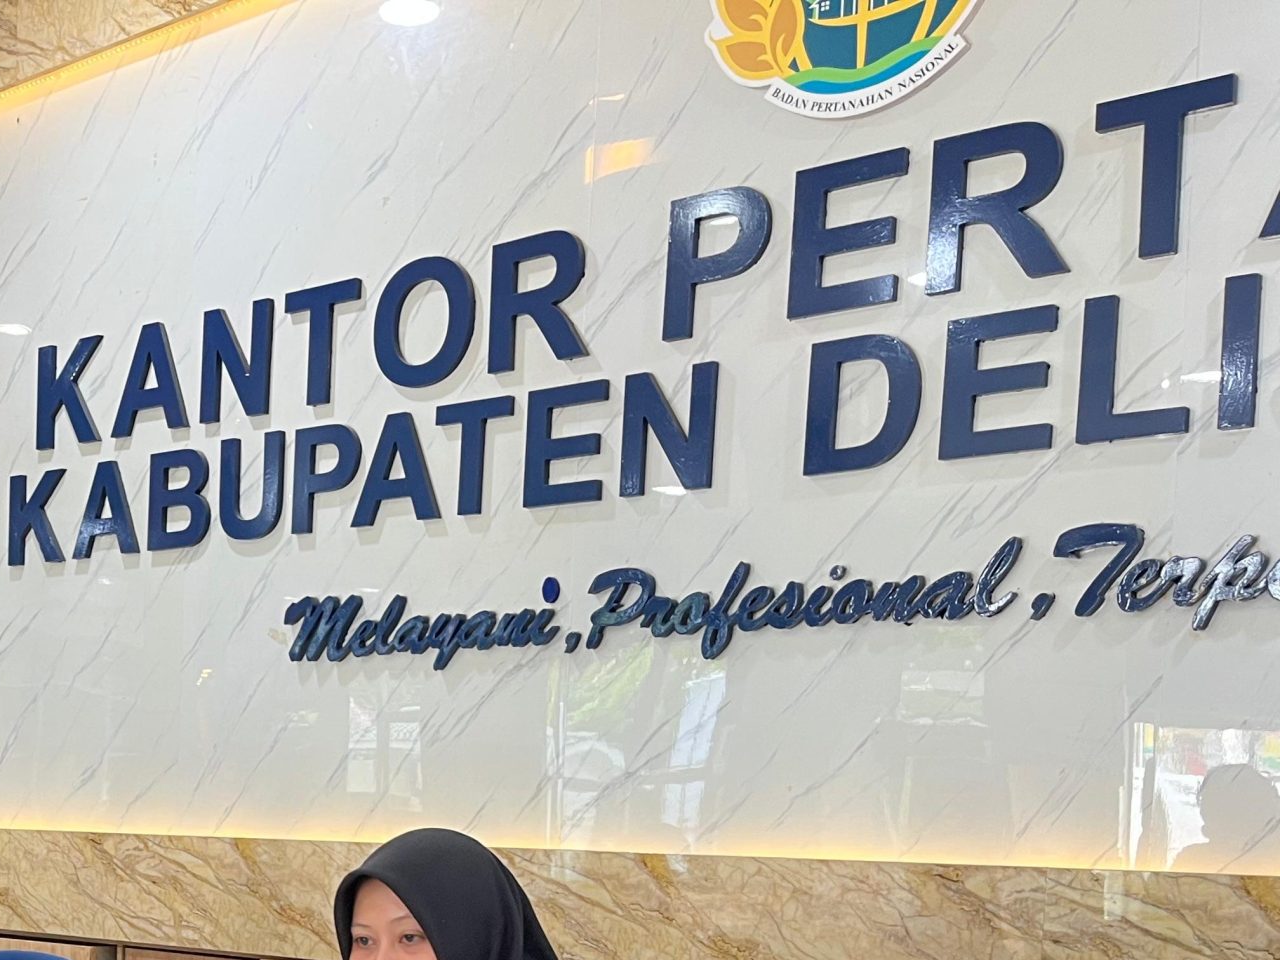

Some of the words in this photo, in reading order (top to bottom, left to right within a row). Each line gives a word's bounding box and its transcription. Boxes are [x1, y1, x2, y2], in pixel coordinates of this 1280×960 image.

[771, 87, 808, 111] BADAN
[810, 87, 895, 113] PERTANAHAN
[897, 41, 960, 92] NASIONAL
[35, 229, 591, 452] KANTOR
[662, 73, 1280, 342] PERT
[7, 361, 719, 567] KABUPATEN
[803, 273, 1263, 477] DELI
[1053, 522, 1280, 631] Terp
